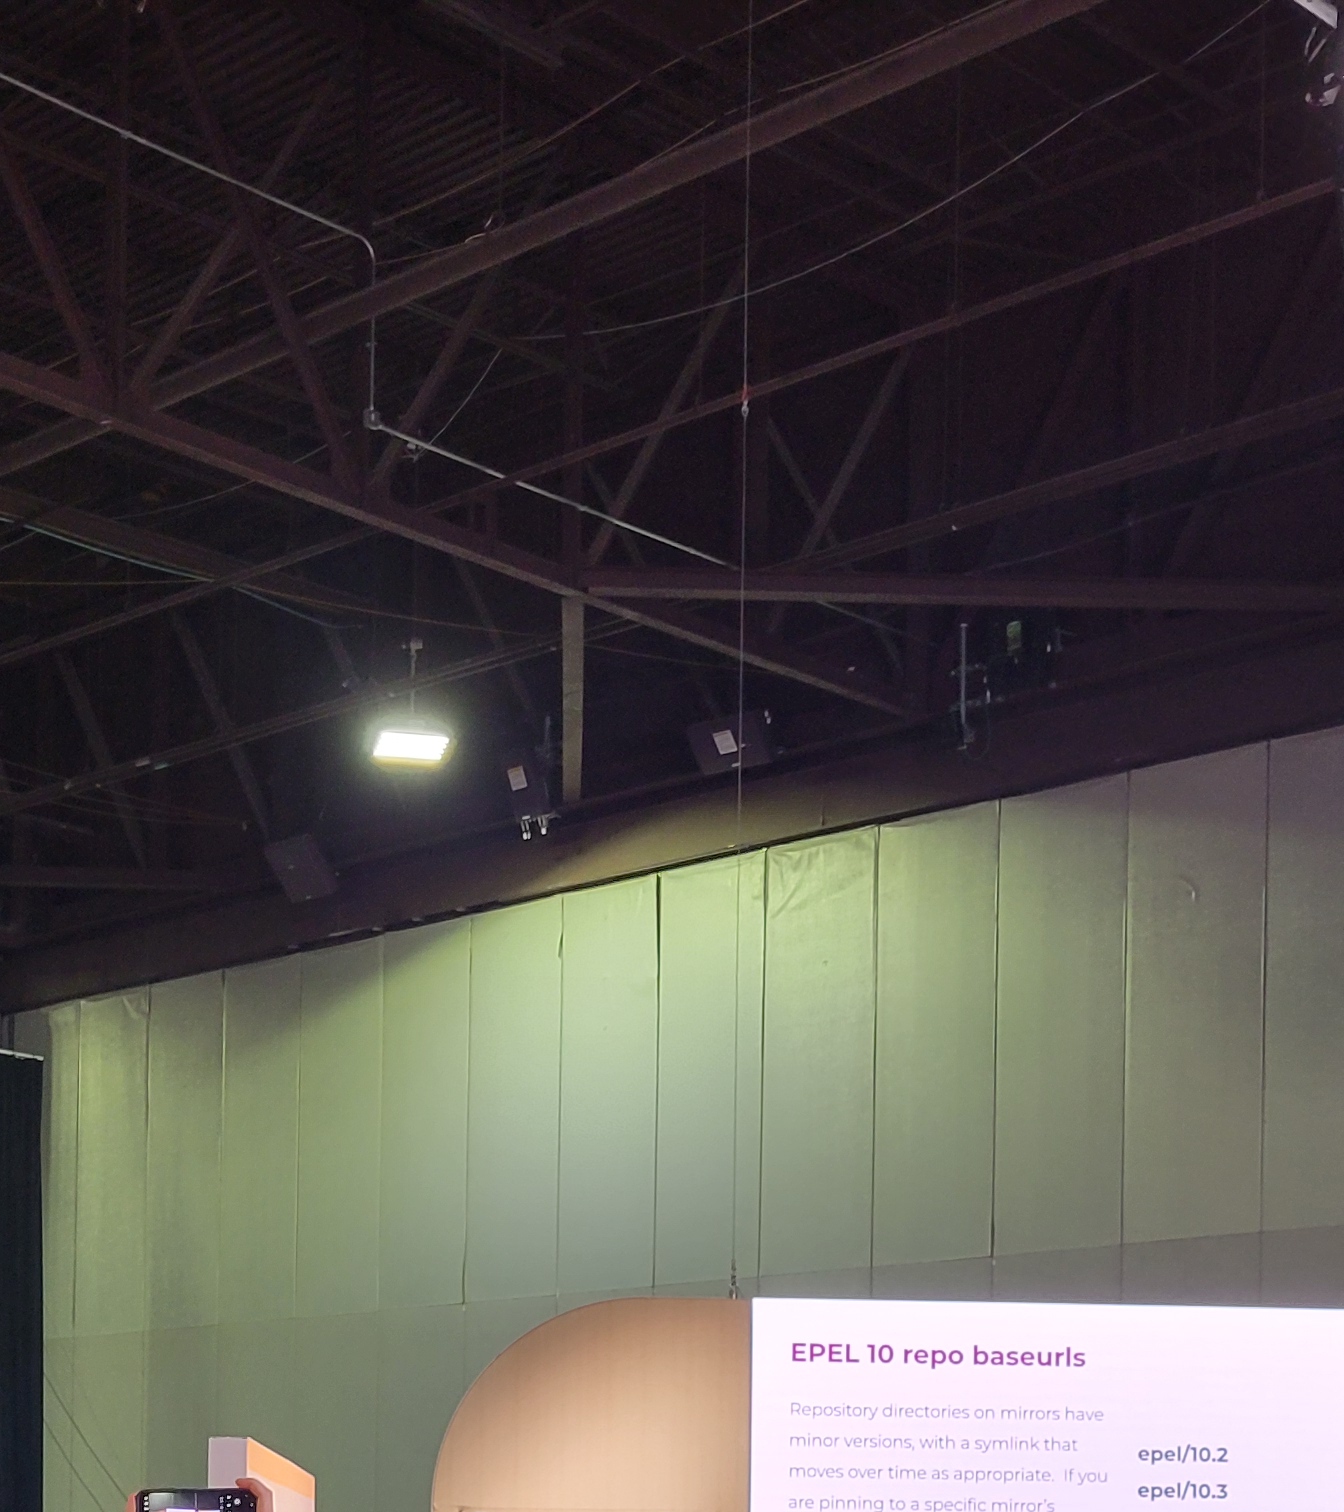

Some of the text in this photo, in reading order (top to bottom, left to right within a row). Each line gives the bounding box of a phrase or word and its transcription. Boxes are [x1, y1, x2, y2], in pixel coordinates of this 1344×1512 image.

[791, 1342, 1086, 1370] EPEL 10 repo baseurls
[790, 1402, 1104, 1422] Repository directories on mirrors have
[790, 1433, 1078, 1453] minor versions, with a symlink that
[1138, 1443, 1229, 1466] epel/10.2
[789, 1464, 1108, 1486] moves over time as appropriate. If you
[1137, 1480, 1228, 1503] epel/10.3
[788, 1498, 814, 1510] are
[889, 1498, 906, 1511] to
[910, 1500, 920, 1511] a
